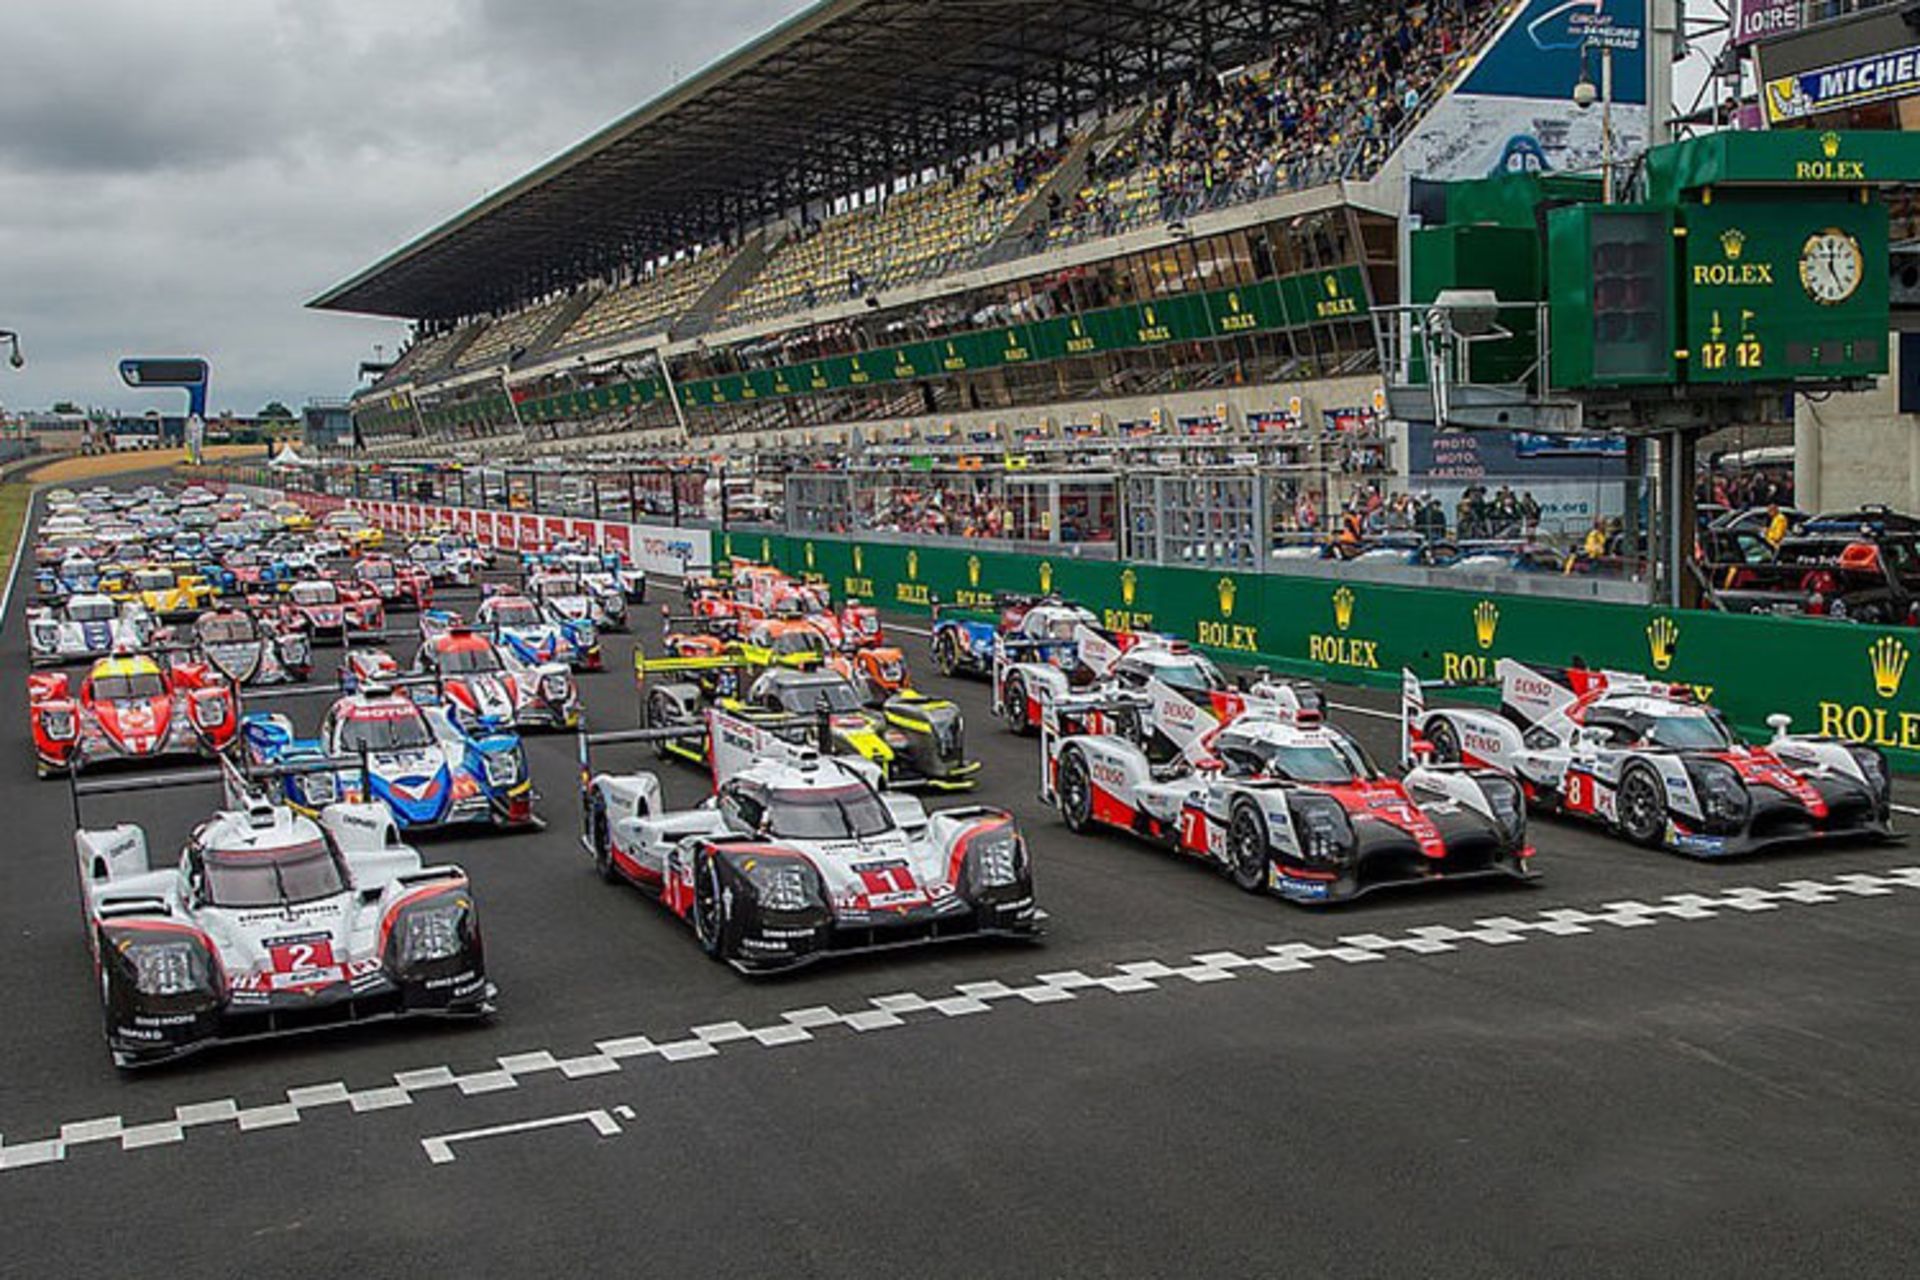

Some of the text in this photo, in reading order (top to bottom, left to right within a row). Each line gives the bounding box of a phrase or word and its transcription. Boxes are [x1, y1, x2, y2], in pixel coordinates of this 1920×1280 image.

[1744, 6, 1797, 34] LOIRE
[1796, 161, 1864, 179] ROLEX
[1693, 263, 1774, 285] ROLEX
[1736, 342, 1763, 367] 12
[1199, 621, 1259, 652] ROLEX
[1310, 634, 1379, 669] ROLEX
[1443, 652, 1501, 682] ROL
[1514, 677, 1551, 698] DENSO
[354, 705, 416, 719] MOTUL
[1162, 701, 1195, 720] DENSO
[1819, 701, 1920, 750] ROLE
[1464, 734, 1500, 753] DENSO
[1569, 776, 1580, 804] 8
[1184, 813, 1195, 843] 7
[876, 870, 899, 892] 1
[289, 944, 317, 972] 2
